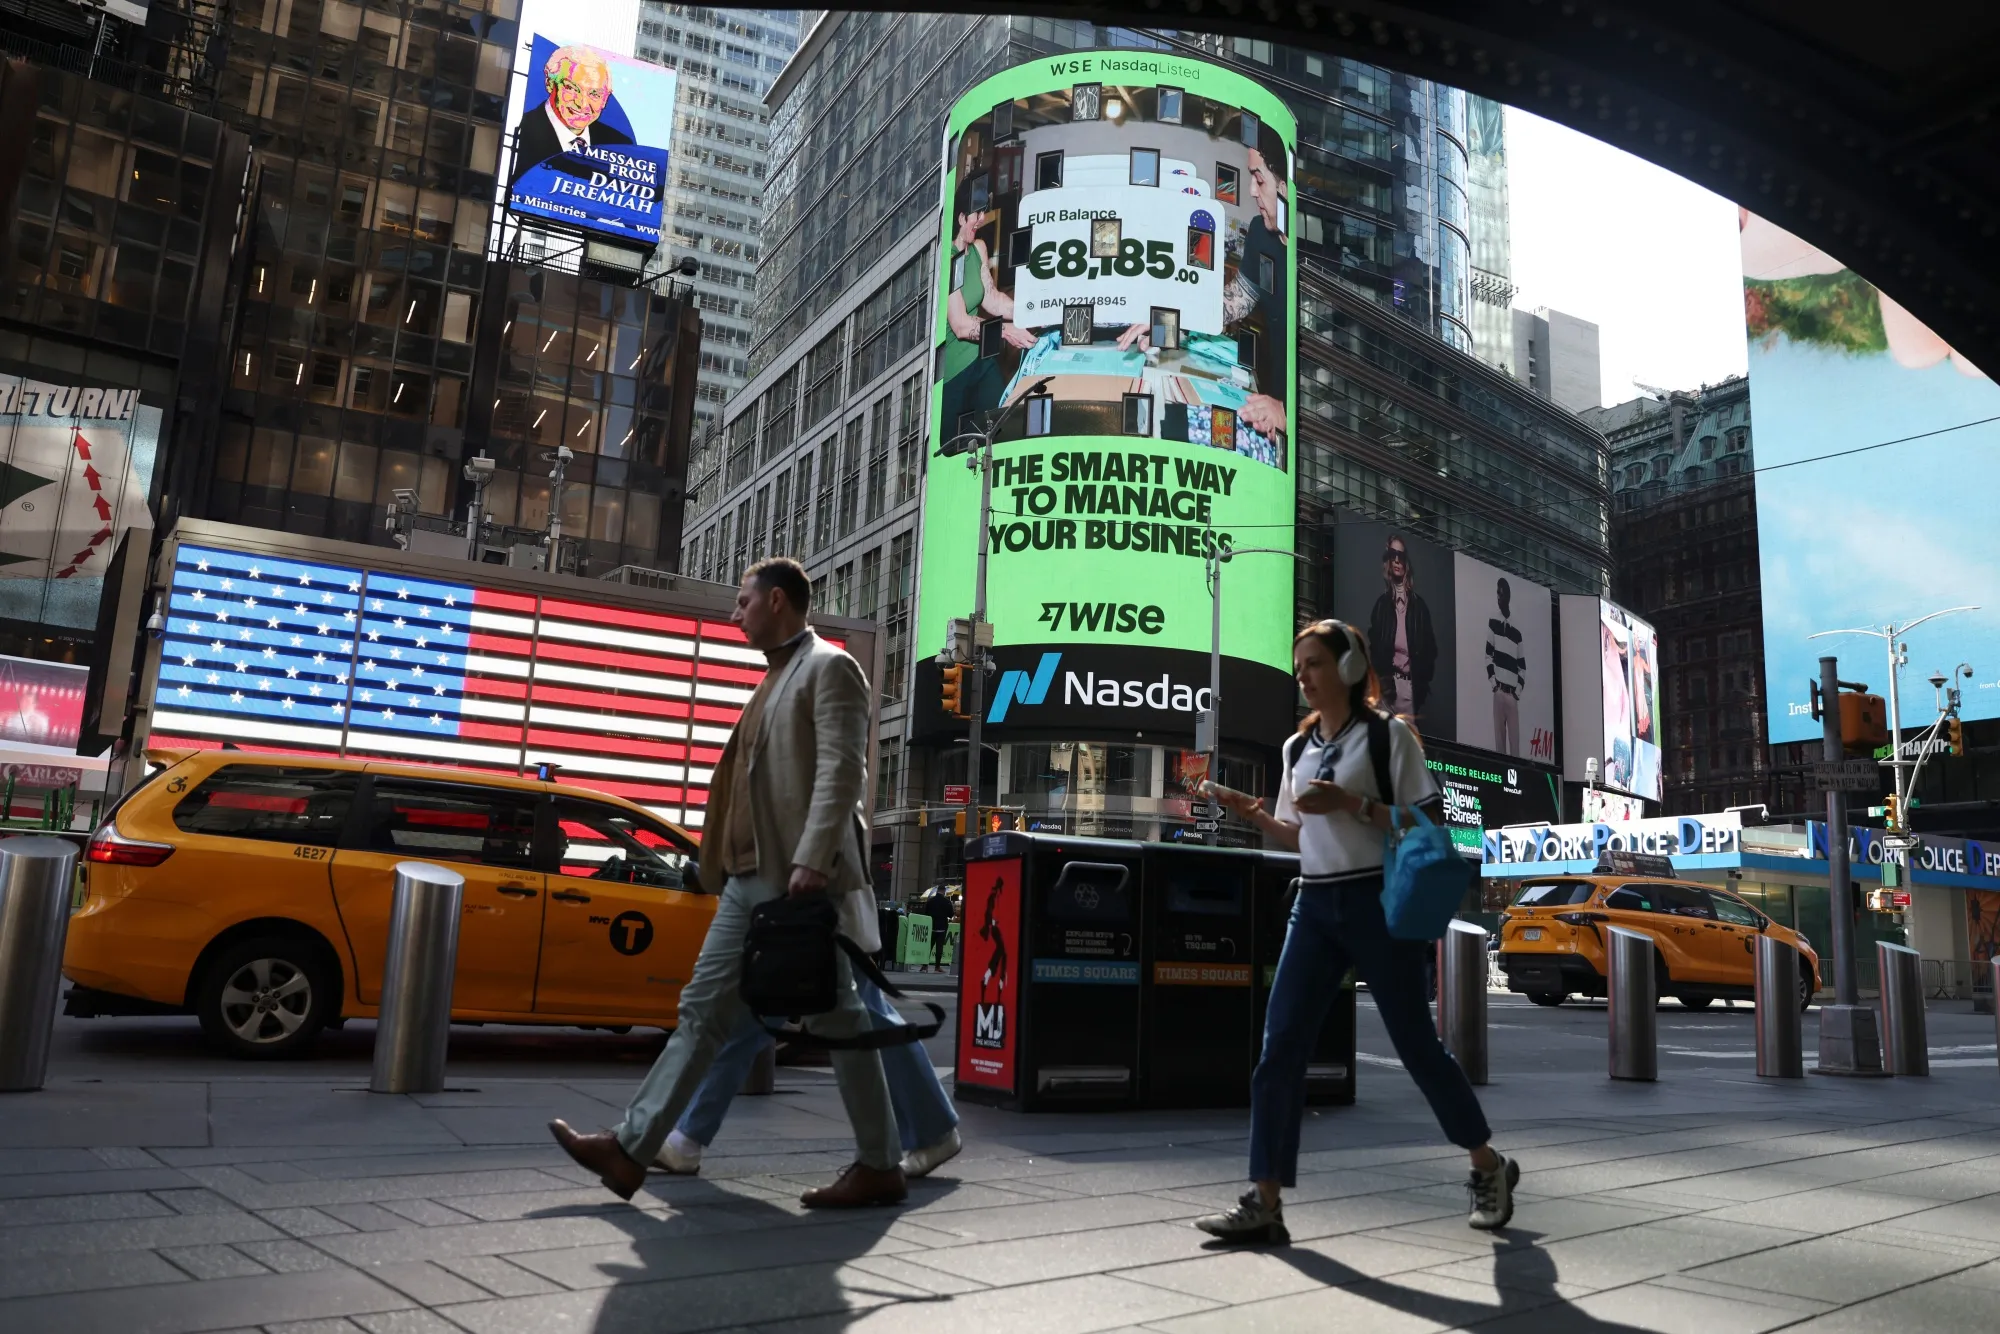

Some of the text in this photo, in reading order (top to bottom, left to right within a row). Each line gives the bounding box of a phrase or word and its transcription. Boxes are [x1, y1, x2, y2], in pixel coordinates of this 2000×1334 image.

[1049, 59, 1092, 77] WSE
[569, 141, 657, 174] A MESSAGE
[589, 171, 655, 200] DAVID
[609, 164, 656, 185] FROM
[549, 176, 655, 214] JEREMIAH
[524, 196, 587, 219] Ministries
[1027, 208, 1117, 226] EUR Balance
[1040, 296, 1127, 310] IBAN 22148945
[989, 451, 1238, 496] THE SMART WAY
[1011, 484, 1212, 523] TO MANAGE
[988, 519, 1234, 563] YOUR BUSINESS
[1530, 727, 1554, 760] H&M
[1425, 759, 1503, 783] IDEO PRESS RELEASES
[1445, 780, 1472, 791] DISTRIBUTED
[1451, 789, 1474, 809] New
[1040, 823, 1062, 831] Nasdaq
[1451, 806, 1482, 826] Street
[1481, 817, 1743, 865] NEW YORK POLICE DEPT
[293, 847, 327, 862] 4E27
[1911, 845, 1964, 873] OLICE
[1035, 964, 1137, 979] TIMES SQUARE
[1157, 967, 1249, 981] TIMES SQUARE
[976, 1004, 1004, 1040] MJ
